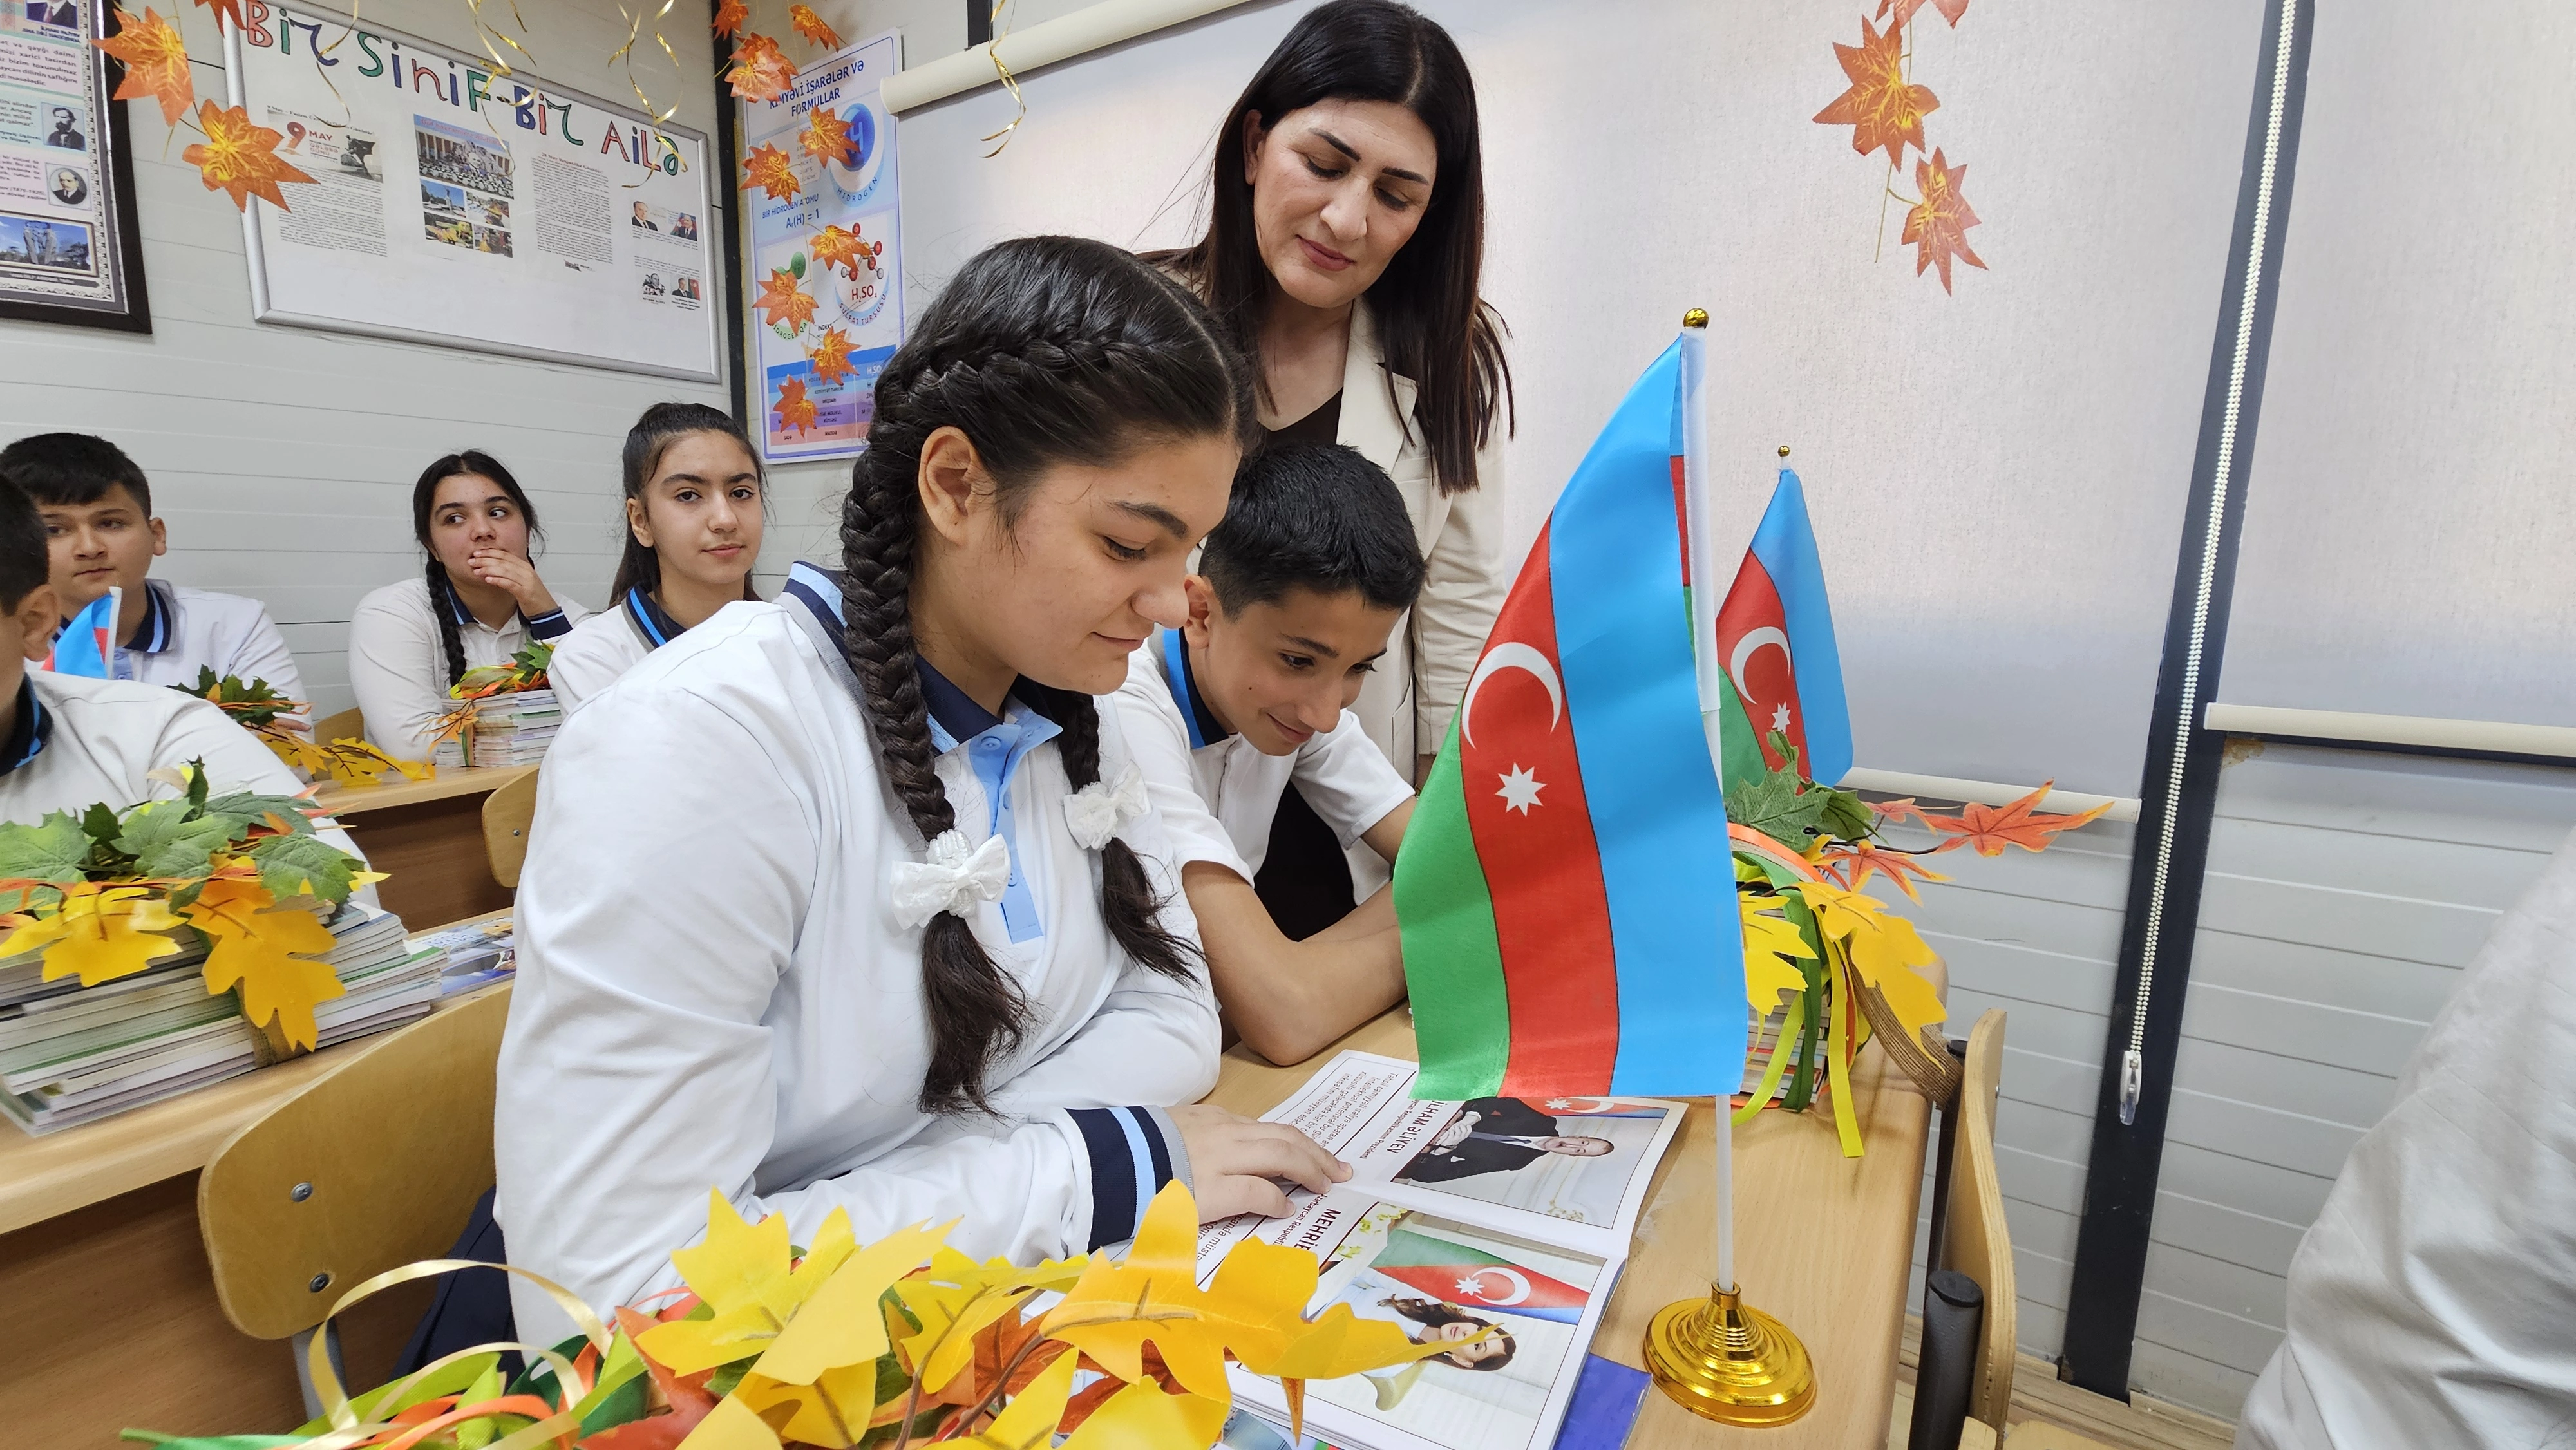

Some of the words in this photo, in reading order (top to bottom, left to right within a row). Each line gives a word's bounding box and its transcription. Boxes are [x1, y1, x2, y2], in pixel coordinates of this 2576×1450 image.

[806, 66, 849, 95] İŞARƏLƏR
[851, 60, 864, 74] VƏ
[791, 88, 840, 117] FORMULLAR
[308, 130, 333, 141] MAY
[799, 193, 819, 206] AOMU
[1380, 1073, 1399, 1087] Təhsil
[1327, 1101, 1352, 1125] potensial
[1413, 1100, 1448, 1125] İLHAM
[1320, 1123, 1332, 1131] bu
[1327, 1123, 1347, 1140] aparan
[1359, 1139, 1384, 1159] Prezidenti
[1387, 1126, 1421, 1154] ƏLİYEV
[1296, 1194, 1327, 1220] Azərbaycan
[1273, 1221, 1302, 1245] Respubli
[1197, 1237, 1220, 1261] müstə
